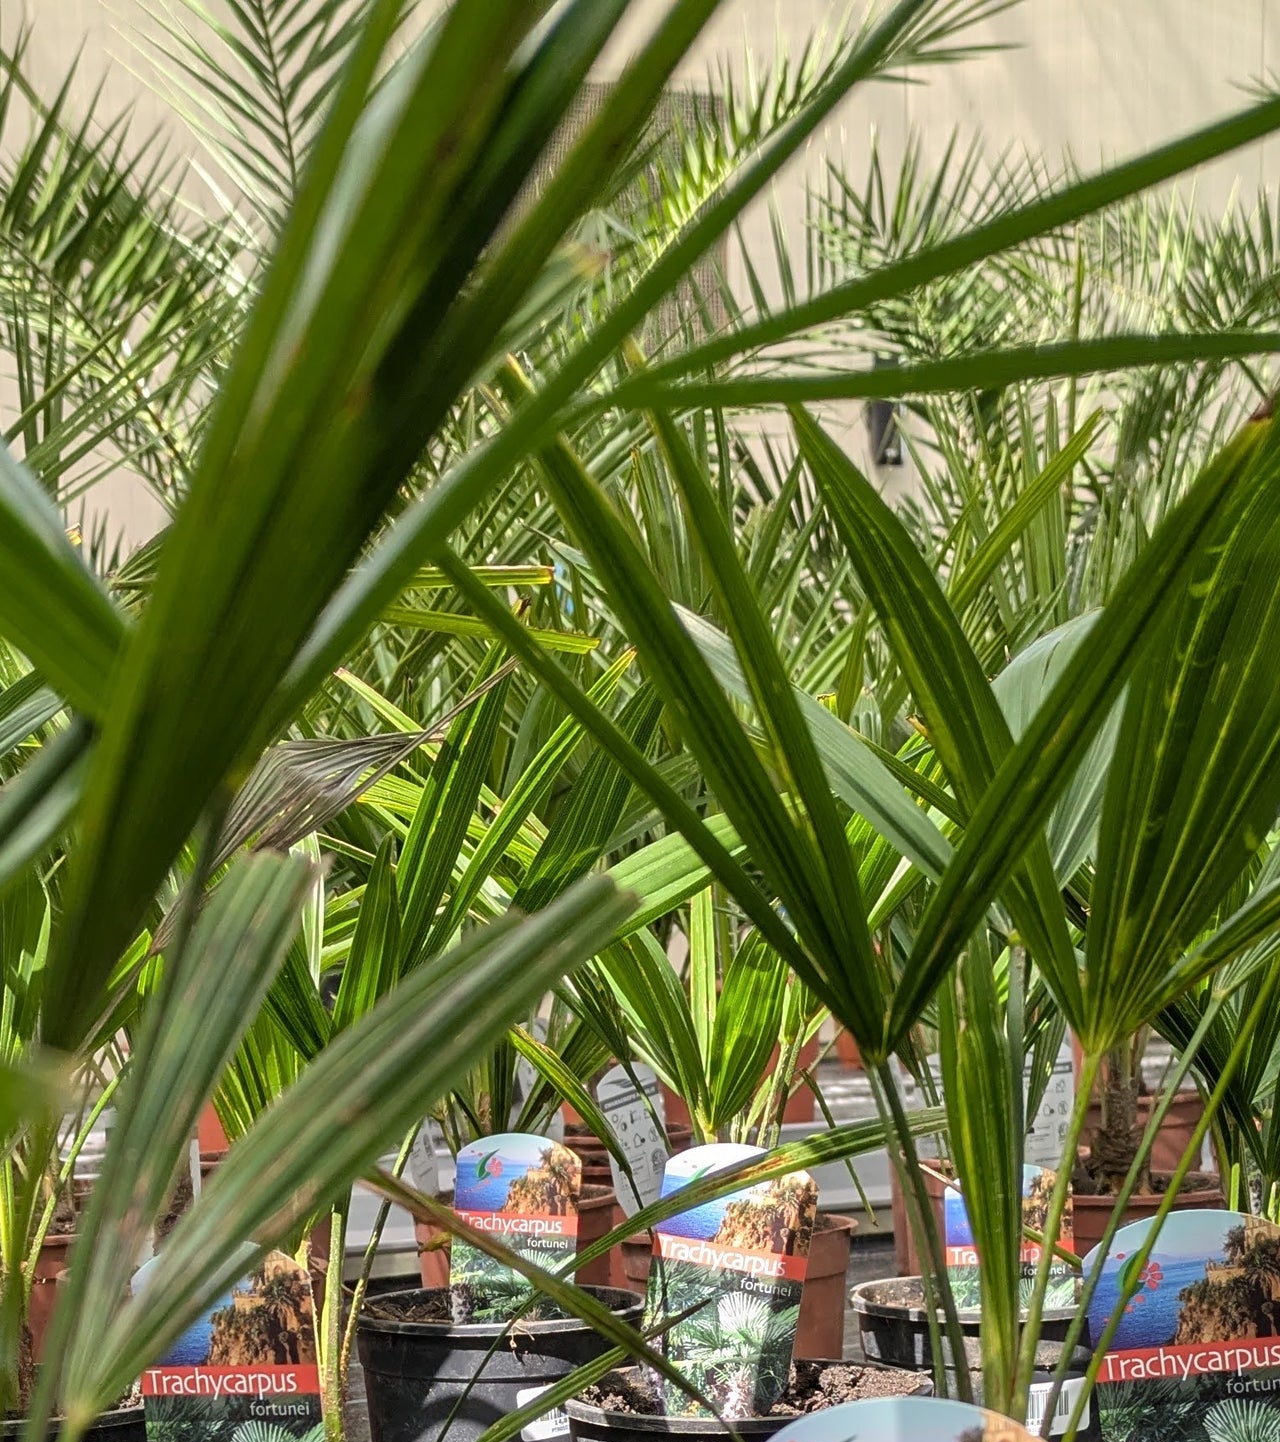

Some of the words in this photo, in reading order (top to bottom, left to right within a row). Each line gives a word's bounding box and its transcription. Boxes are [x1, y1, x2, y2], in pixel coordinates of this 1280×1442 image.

[527, 1238, 568, 1249] fortunei
[659, 1237, 786, 1278] Trachycarpus
[740, 1278, 792, 1297] fortunei
[146, 1368, 298, 1400] Trachycarpus
[249, 1402, 310, 1417] fortunei
